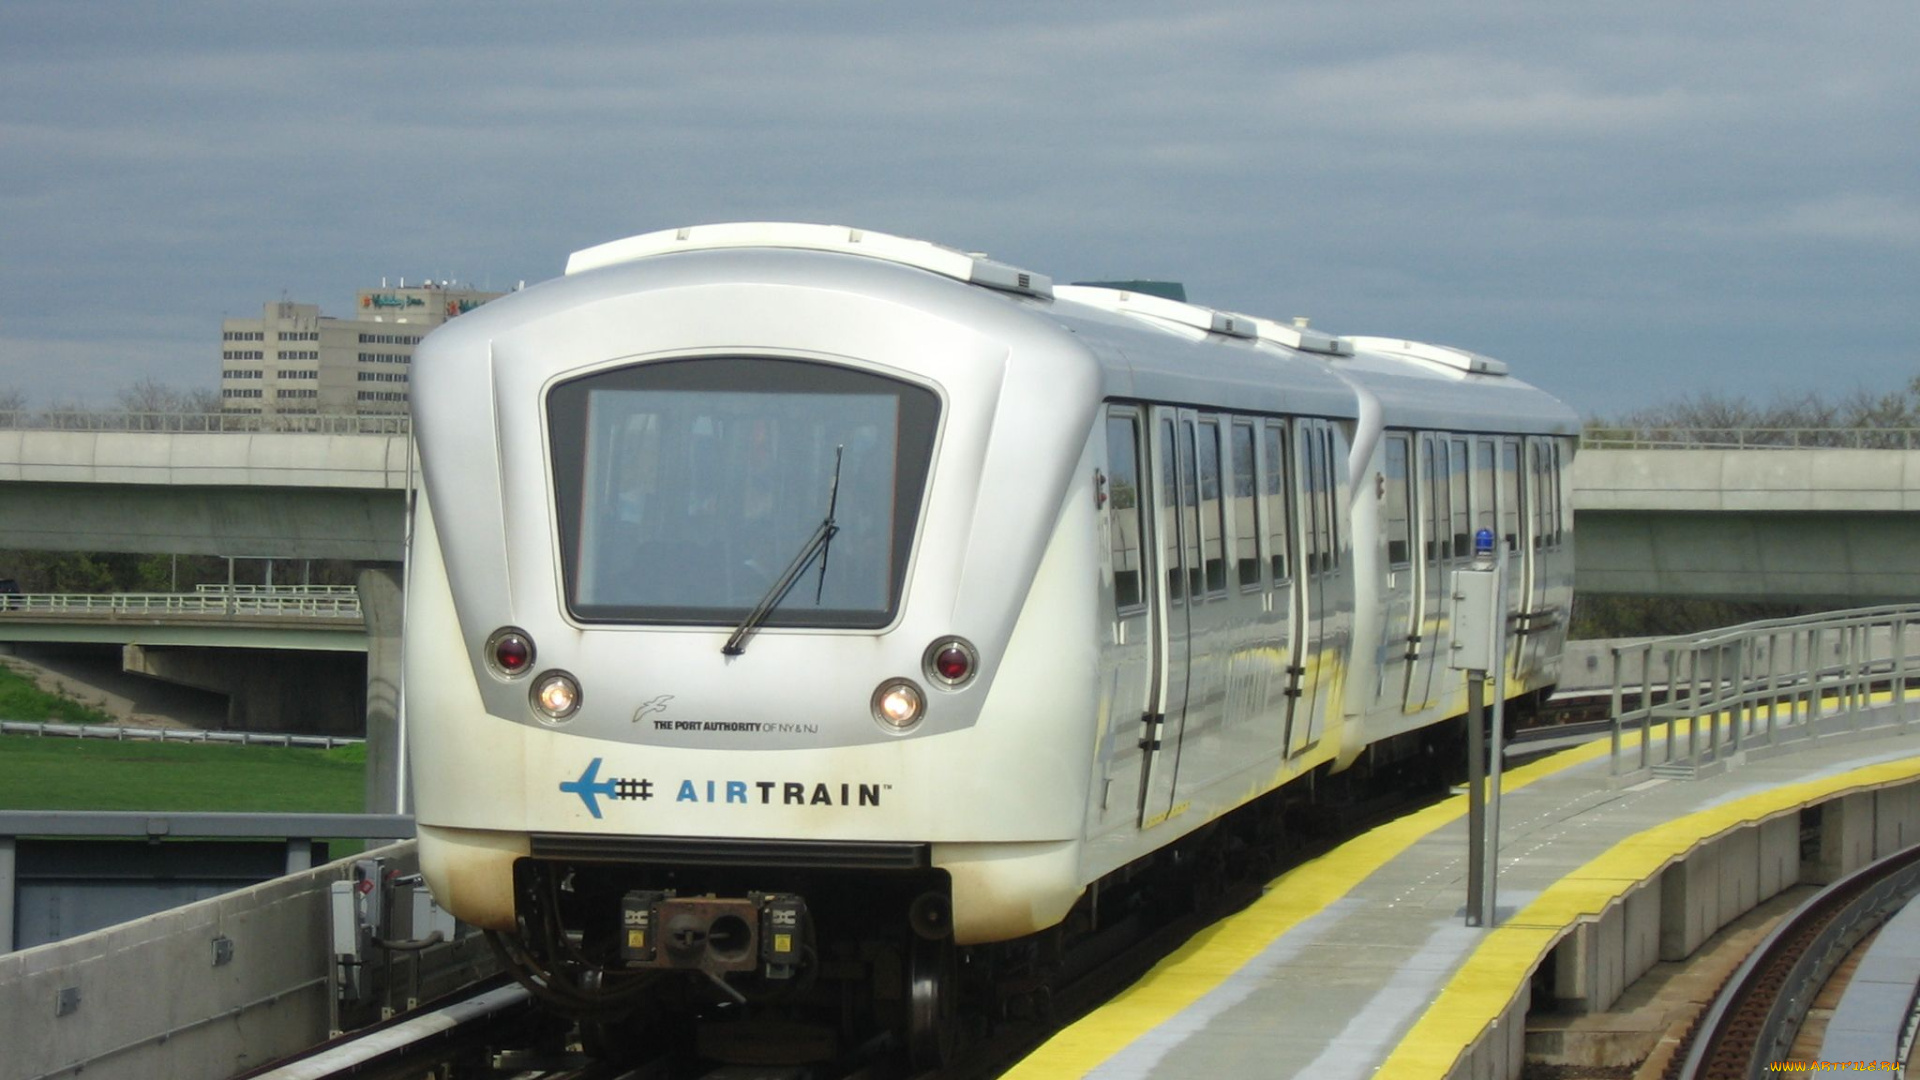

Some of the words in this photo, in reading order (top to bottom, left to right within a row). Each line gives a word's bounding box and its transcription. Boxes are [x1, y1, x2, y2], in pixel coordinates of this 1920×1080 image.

[654, 720, 673, 731] THE
[675, 721, 702, 731] PORT
[703, 721, 762, 732] AUTHORITY
[763, 722, 777, 733] OF
[779, 723, 794, 733] NY
[795, 724, 802, 733] &
[803, 724, 818, 734] NJ
